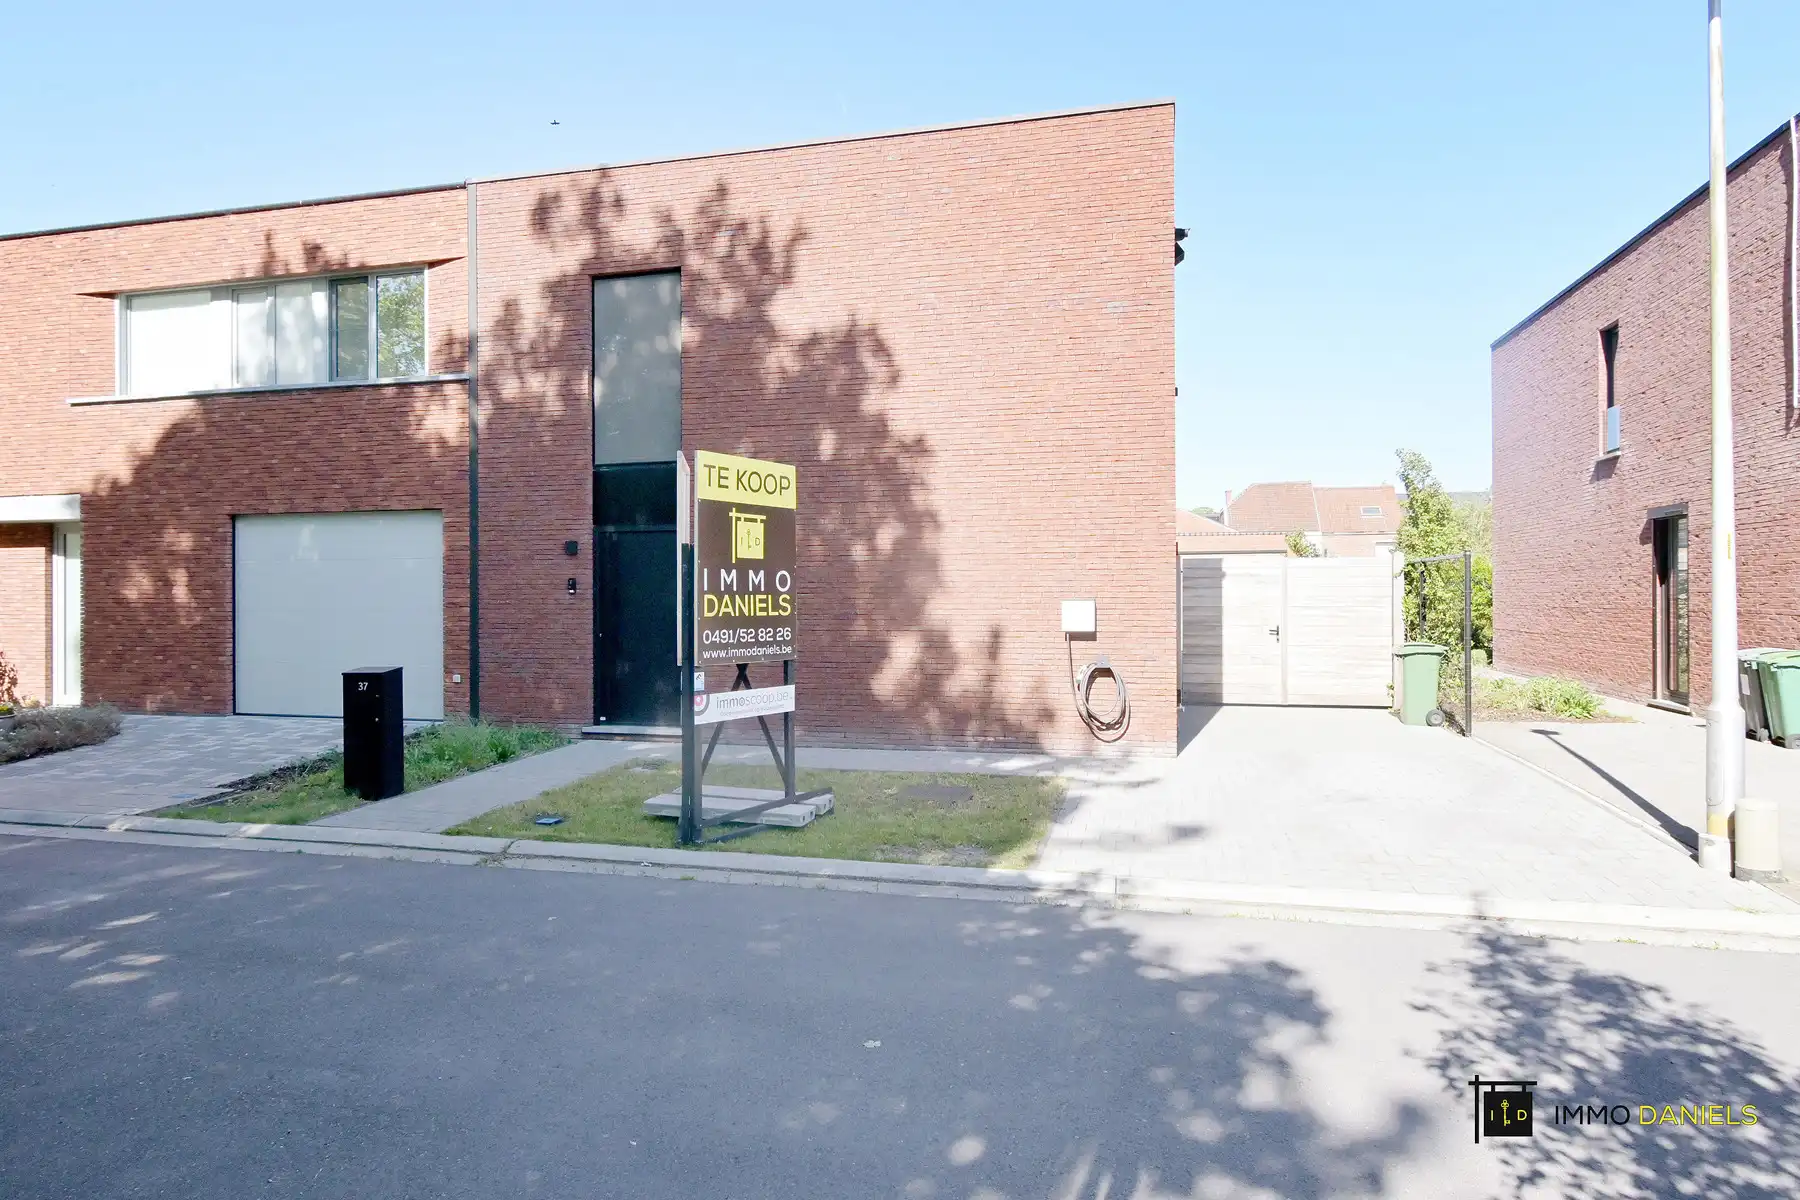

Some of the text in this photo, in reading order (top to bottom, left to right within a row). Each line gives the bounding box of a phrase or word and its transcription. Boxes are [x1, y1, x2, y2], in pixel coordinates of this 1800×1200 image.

[703, 464, 790, 495] TE KOOP
[703, 568, 790, 592] IMMO
[703, 594, 790, 617] DANIELS
[702, 627, 792, 644] 0491/52 82 26
[702, 644, 793, 659] www.immodaniels.be
[358, 682, 368, 690] 37
[716, 691, 789, 709] immoscoop.be
